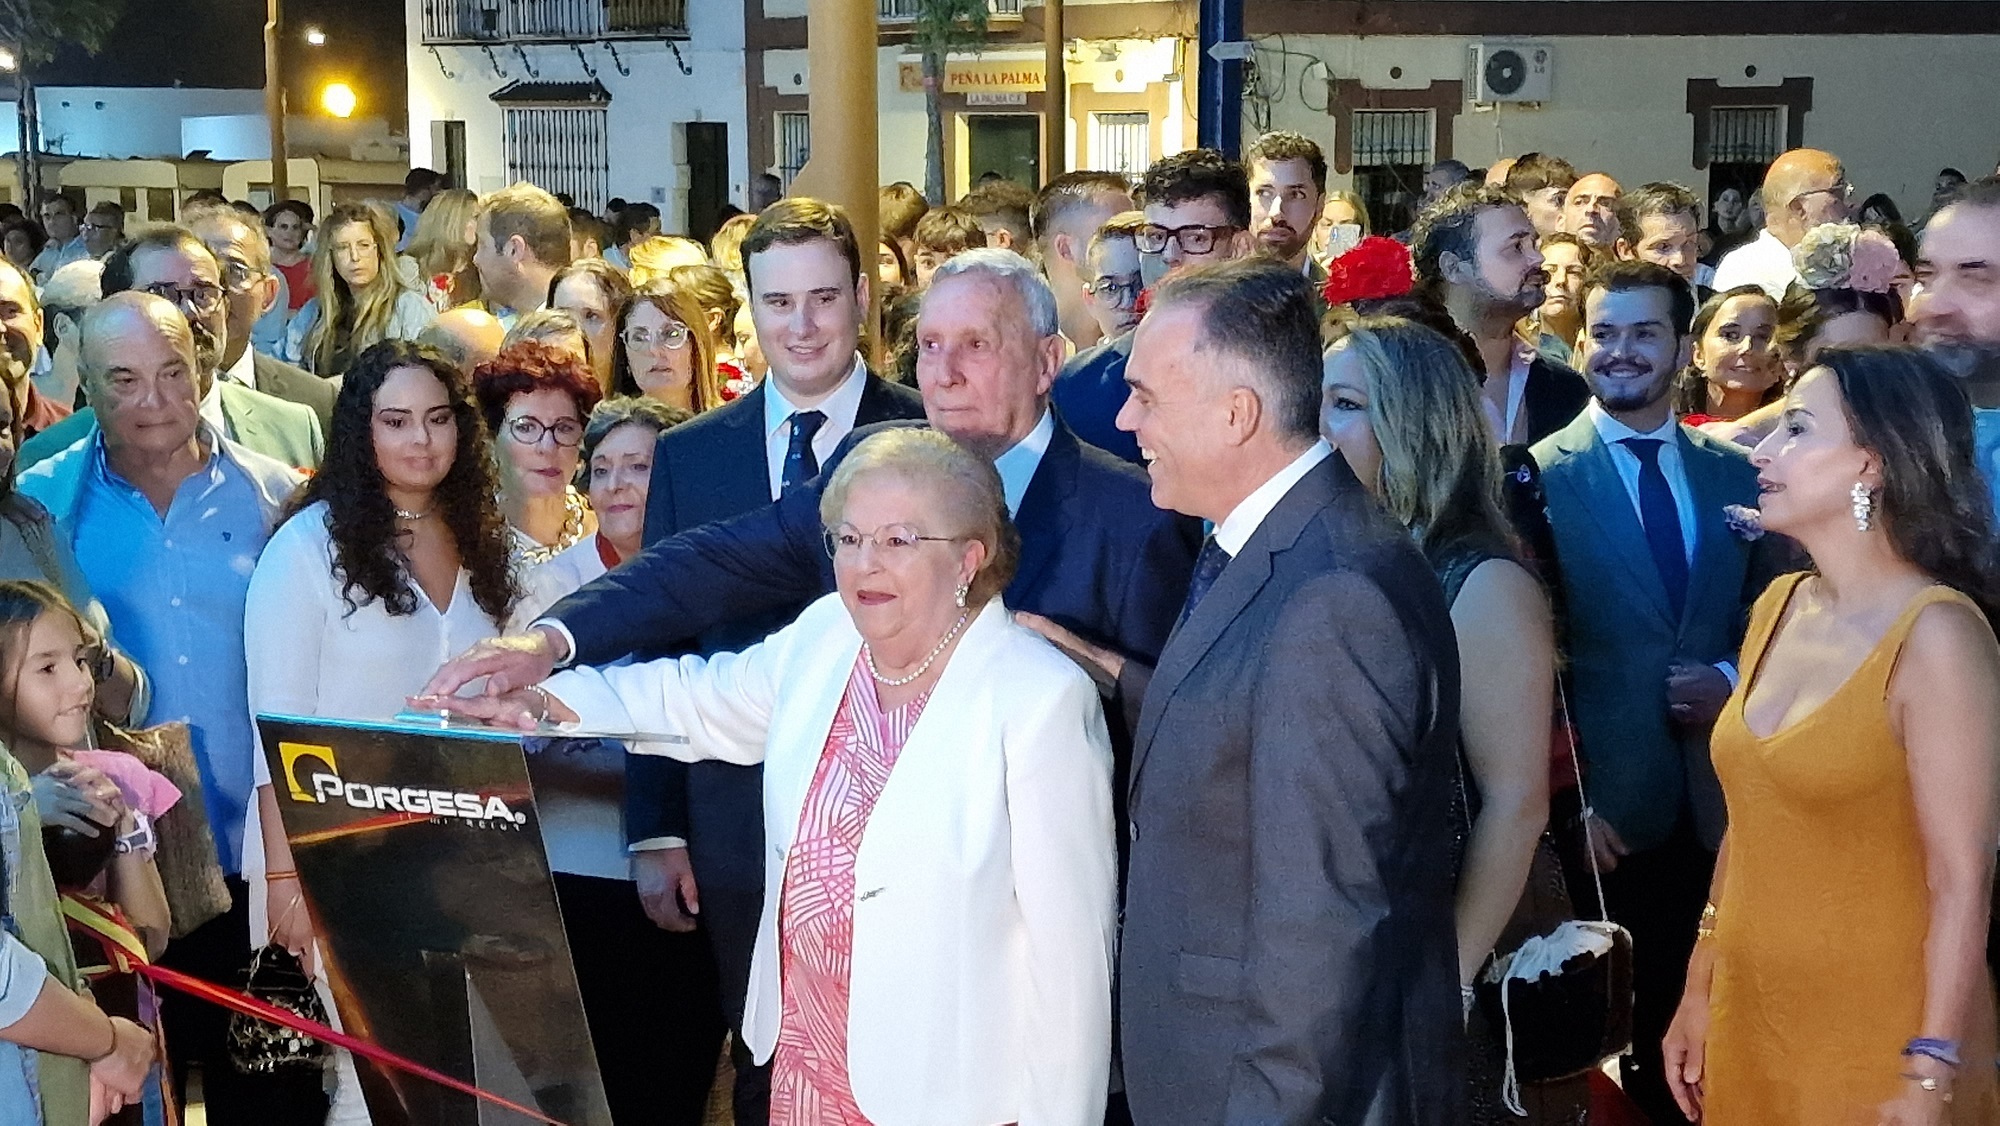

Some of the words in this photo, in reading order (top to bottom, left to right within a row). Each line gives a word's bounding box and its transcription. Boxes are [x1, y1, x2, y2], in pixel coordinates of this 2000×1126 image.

[951, 71, 980, 86] PEÑA
[983, 72, 998, 85] LA
[1001, 72, 1040, 85] PALMA
